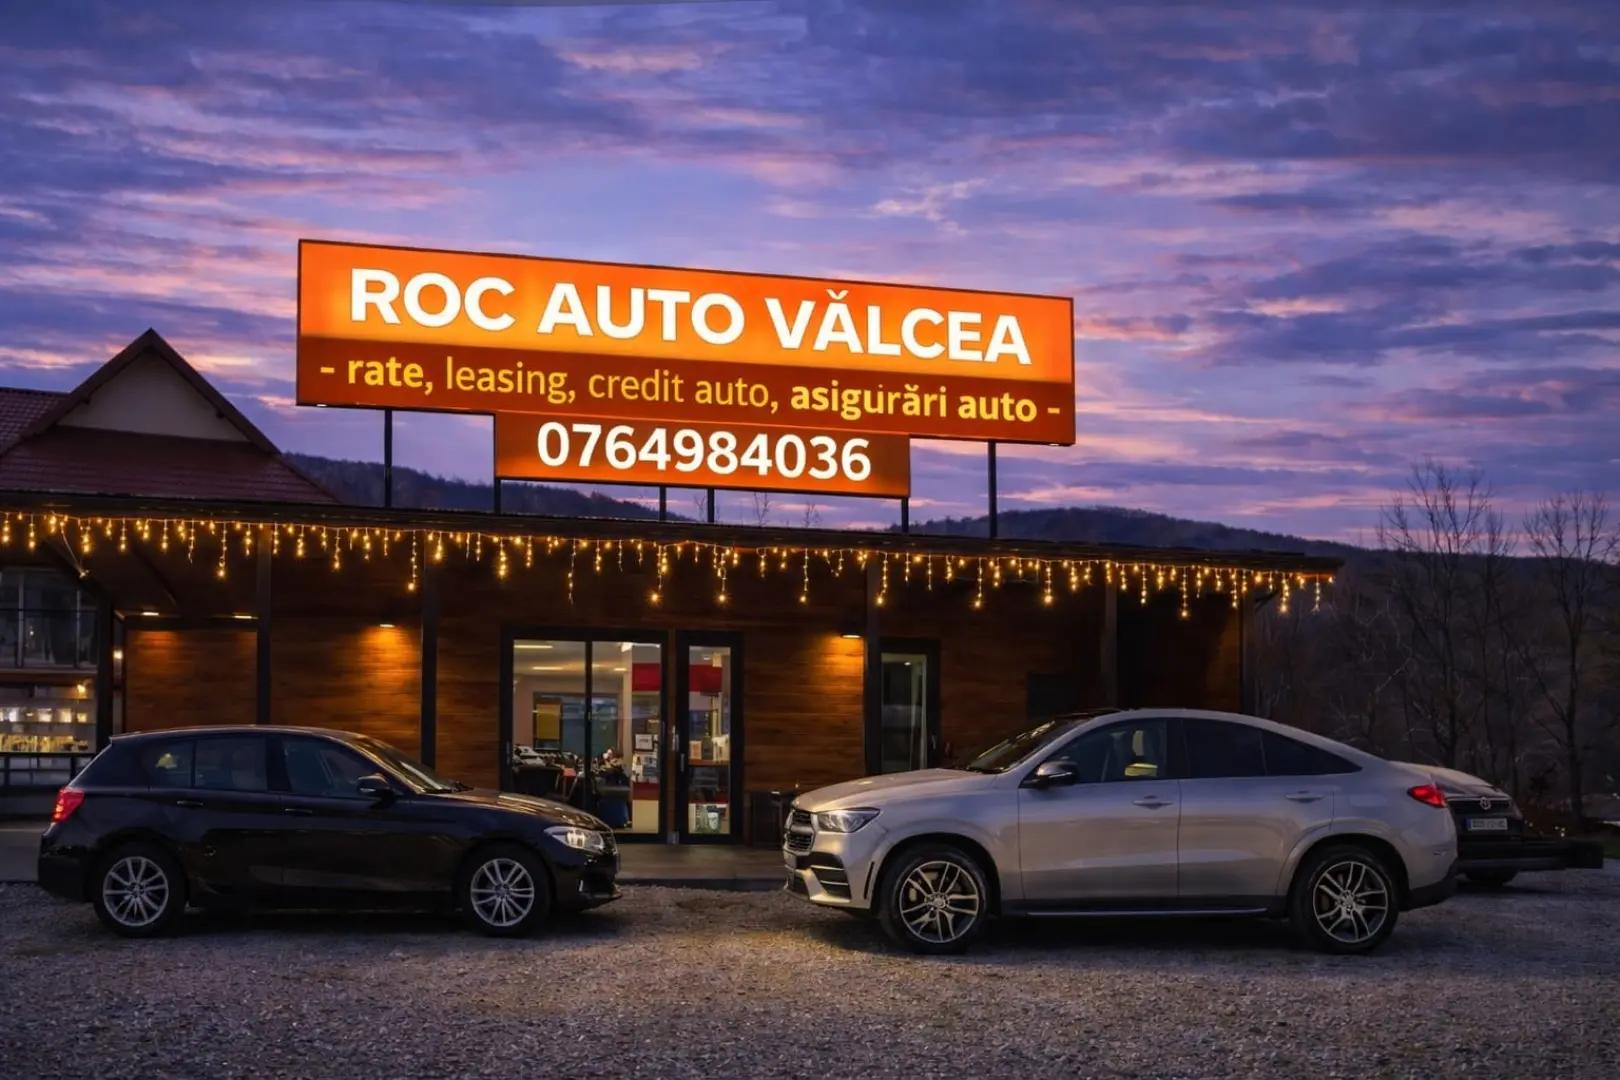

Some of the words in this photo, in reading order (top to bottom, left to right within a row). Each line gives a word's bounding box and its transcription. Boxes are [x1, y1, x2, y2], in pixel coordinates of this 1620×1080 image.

[351, 268, 516, 331] ROC
[536, 282, 745, 346] AUTO
[347, 356, 433, 395] rate,
[446, 356, 577, 404] leasing,
[588, 368, 684, 403] credit
[694, 377, 778, 414] auto,
[957, 392, 1037, 422] auto
[537, 421, 872, 482] 0764984036
